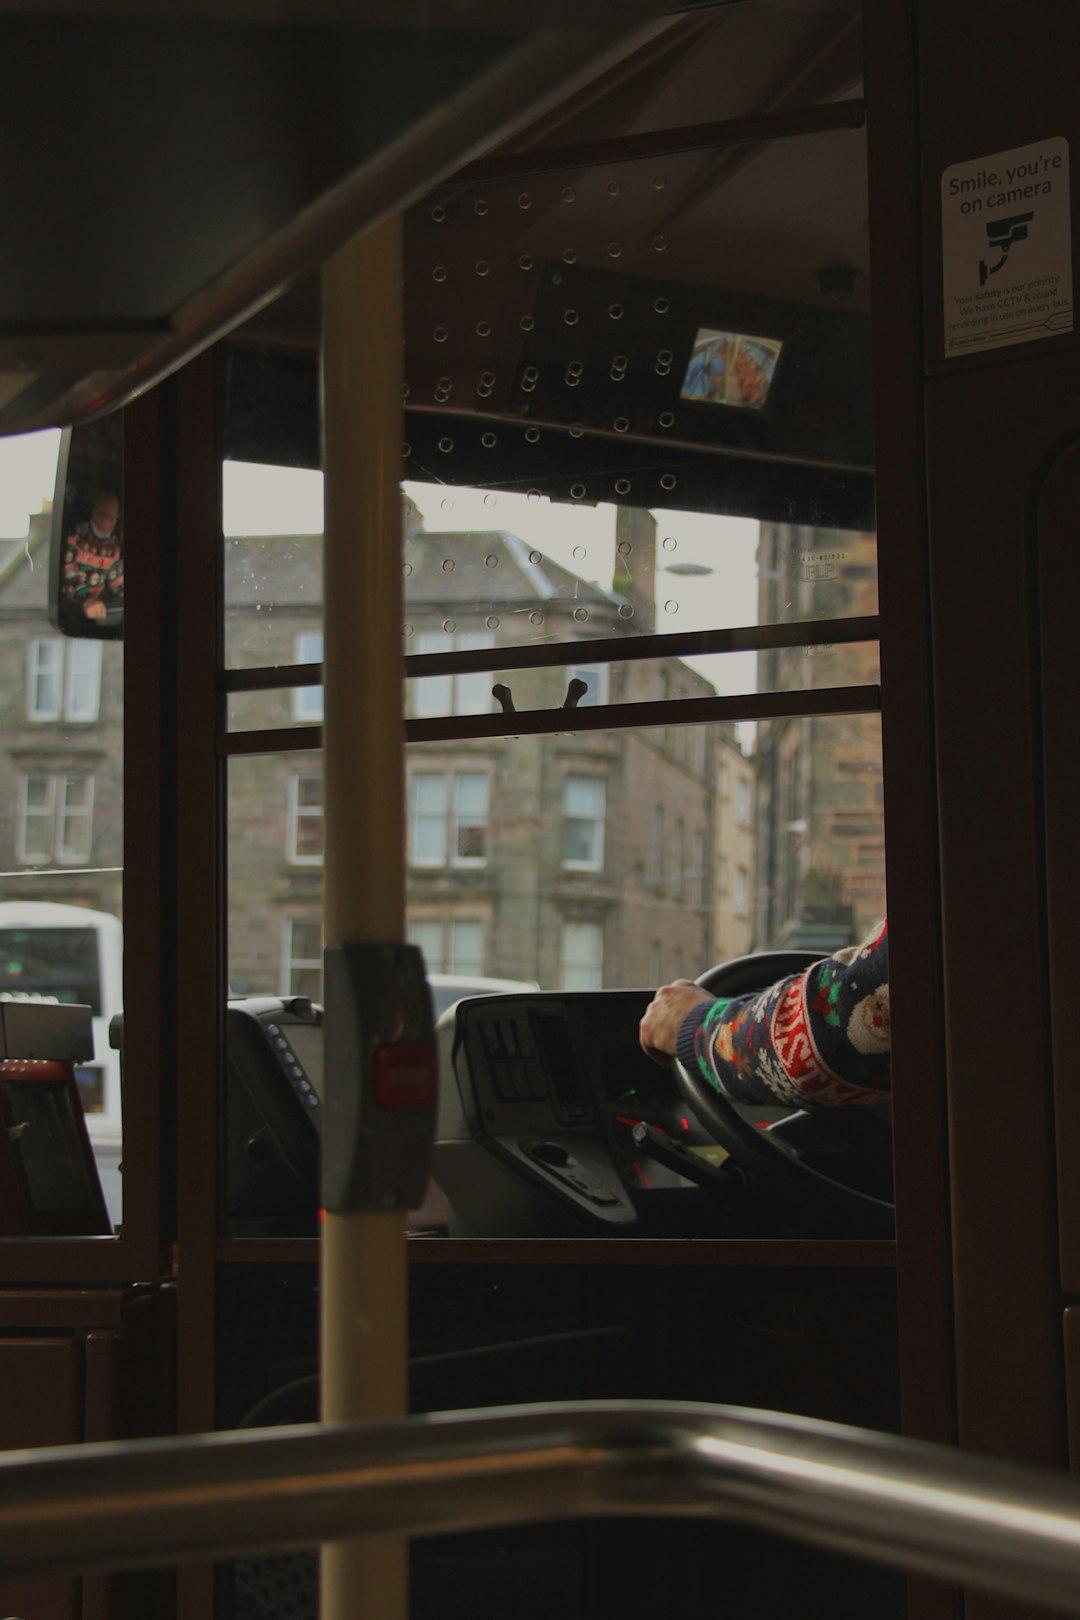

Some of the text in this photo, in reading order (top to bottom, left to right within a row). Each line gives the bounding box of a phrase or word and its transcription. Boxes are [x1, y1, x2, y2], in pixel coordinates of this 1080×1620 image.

[949, 155, 1062, 195] Smile, you're
[960, 180, 1052, 215] on camera
[975, 287, 1002, 302] safety
